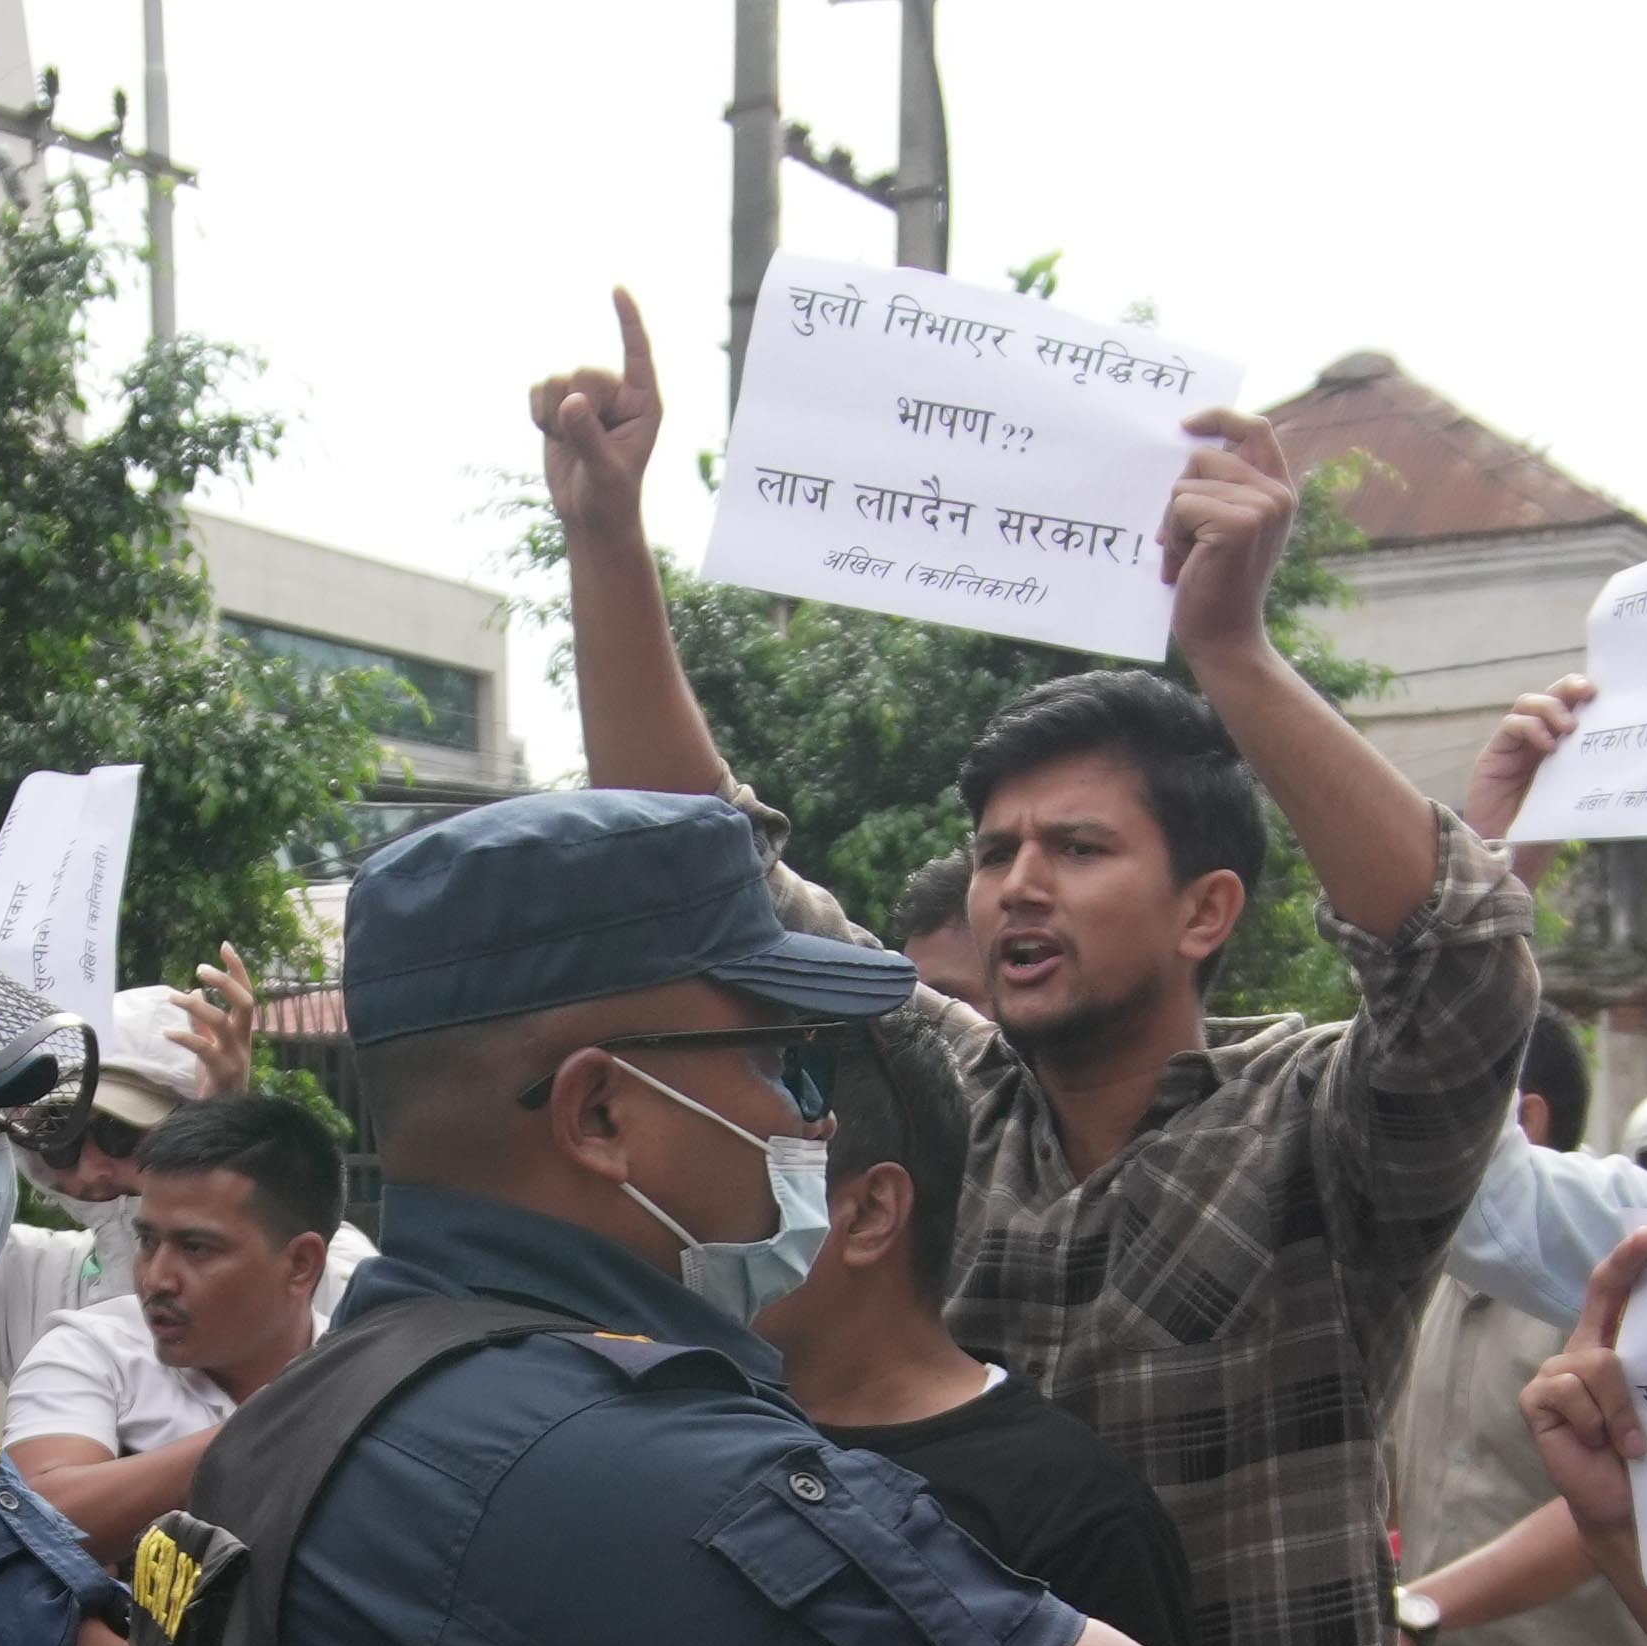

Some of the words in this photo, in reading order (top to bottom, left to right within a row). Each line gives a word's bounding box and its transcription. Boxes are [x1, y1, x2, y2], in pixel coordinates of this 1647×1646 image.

[789, 283, 867, 337] चुलो
[883, 295, 1015, 358] निभाएर
[1036, 340, 1195, 395] समृद्धिको
[755, 467, 834, 512] लाज
[854, 475, 976, 536] लाग्दैन
[996, 507, 1144, 565] सरकार!
[823, 546, 894, 579] अखिल
[905, 560, 1048, 605] (क्रान्तिकारी)
